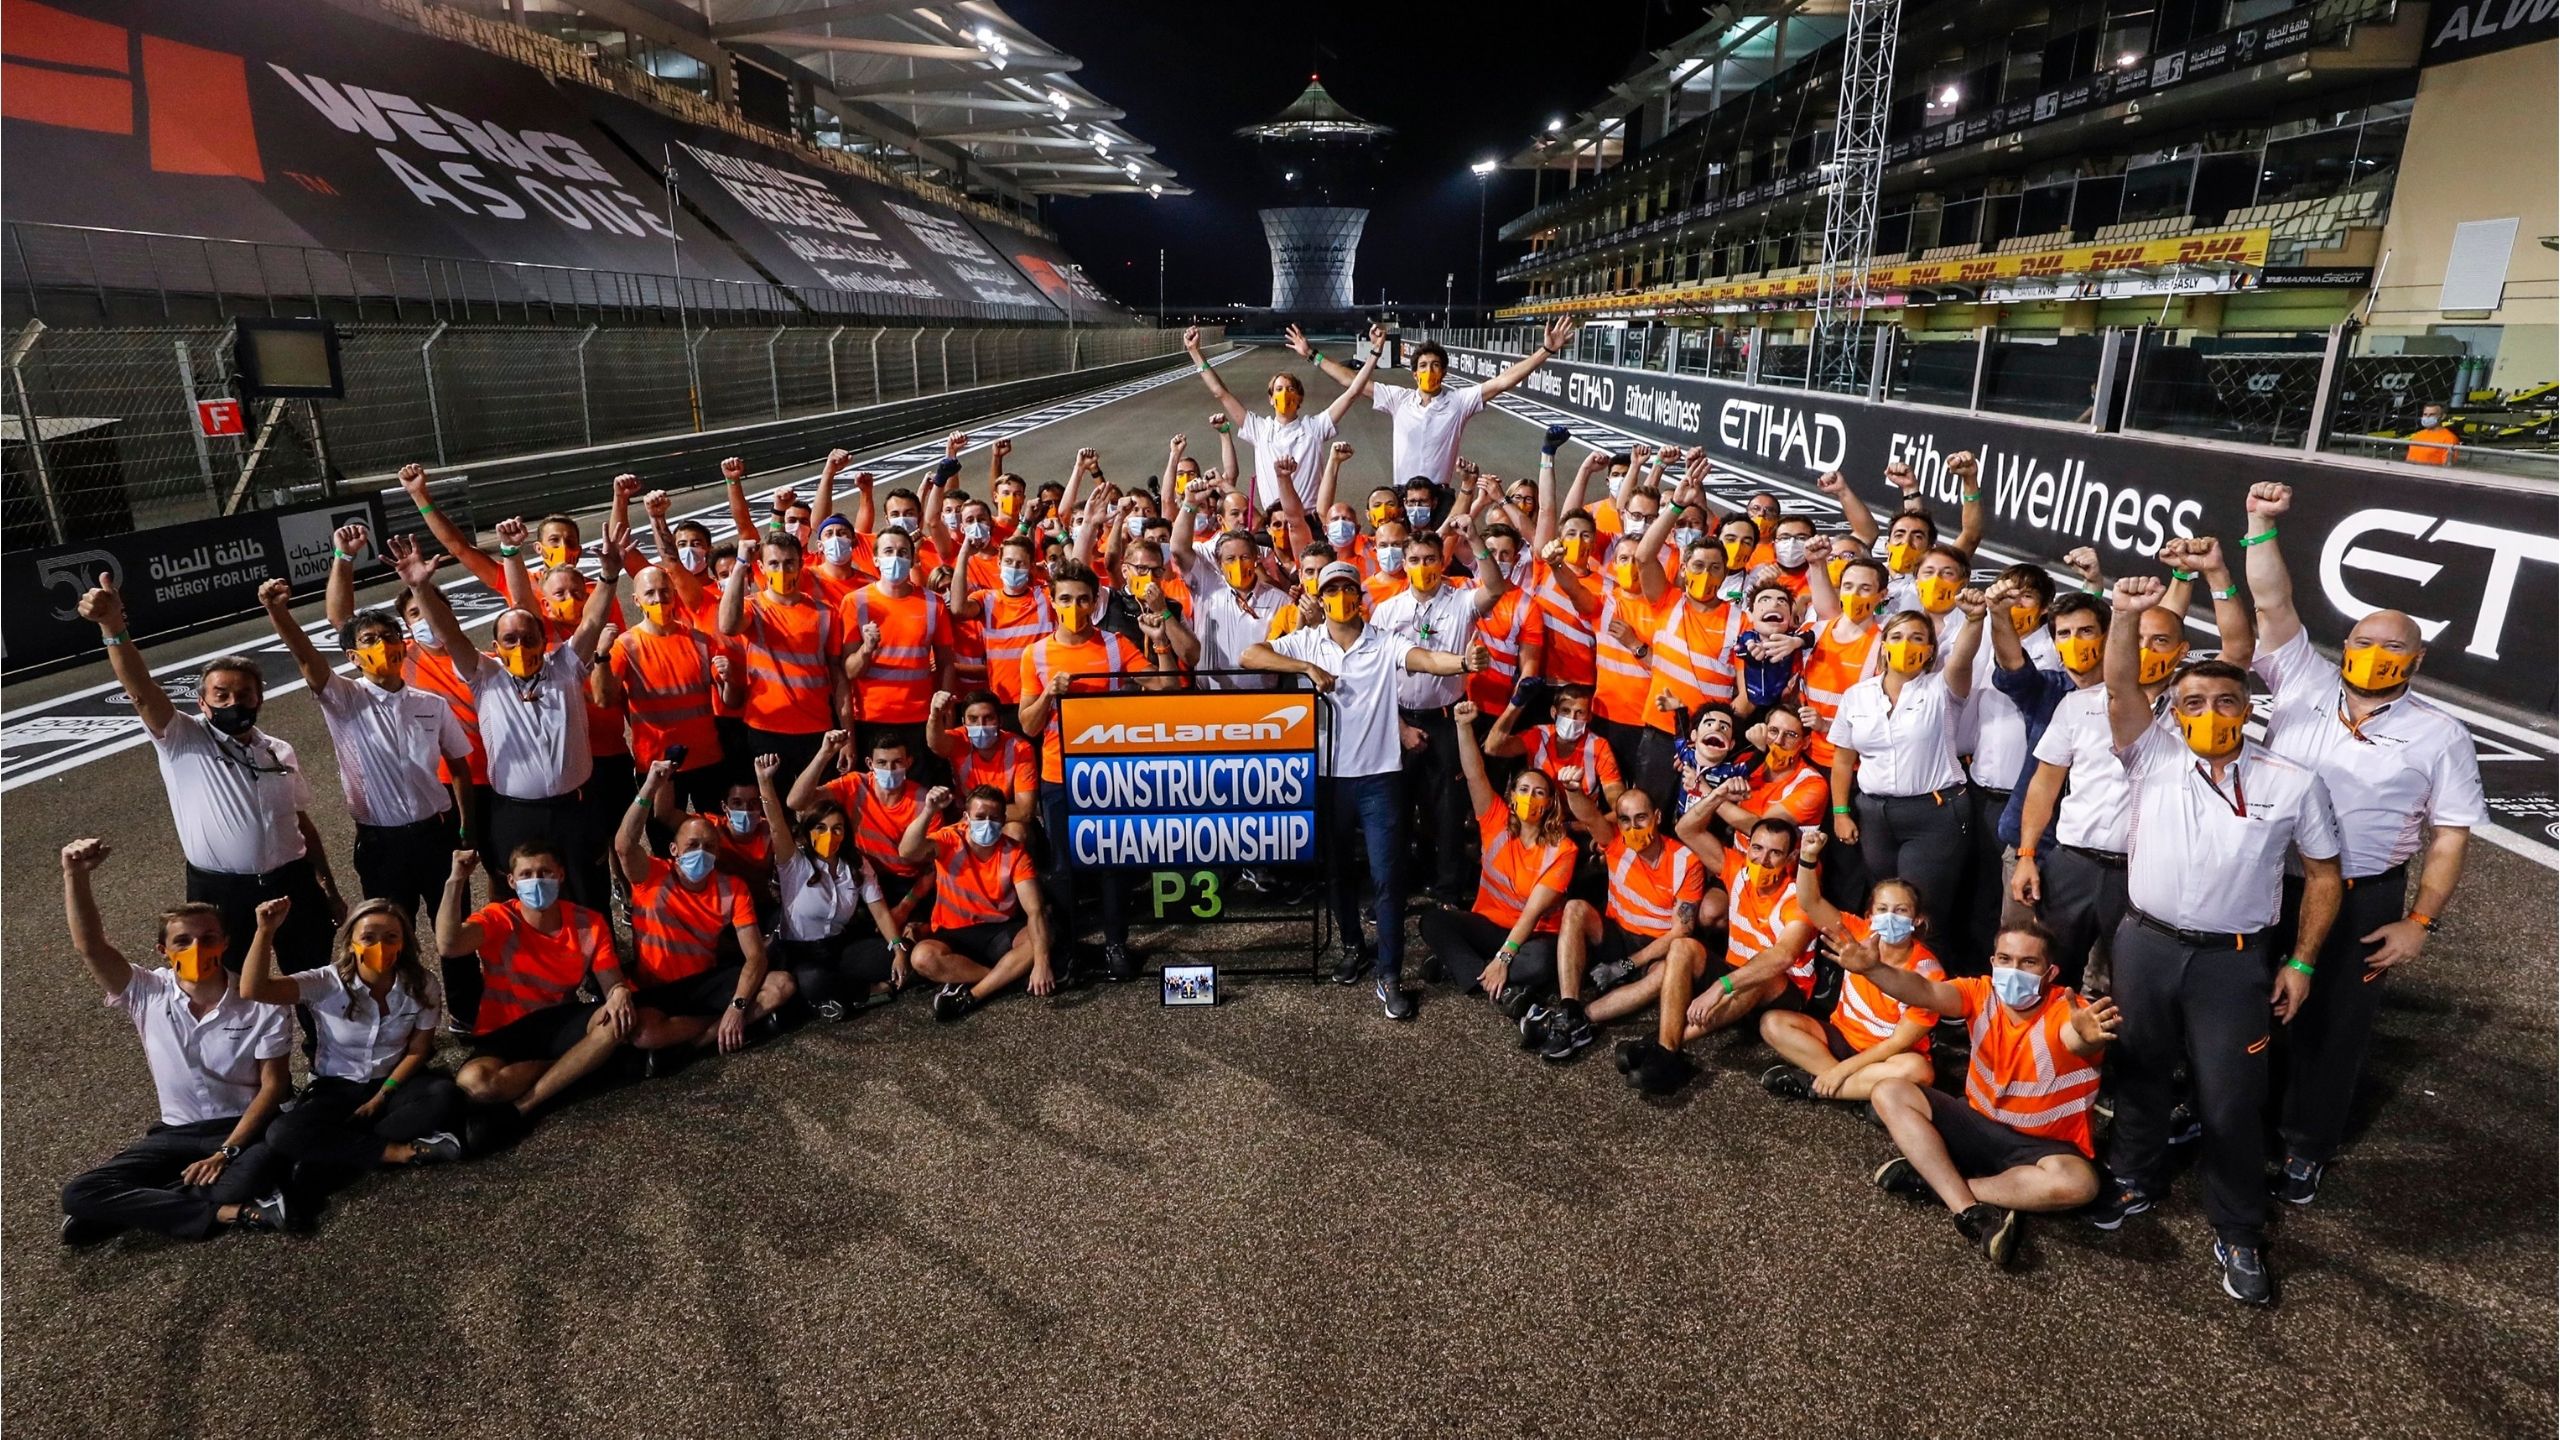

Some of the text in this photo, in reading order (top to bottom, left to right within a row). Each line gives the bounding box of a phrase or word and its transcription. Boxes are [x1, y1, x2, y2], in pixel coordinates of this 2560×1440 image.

[2431, 0, 2559, 48] ALW
[2284, 35, 2295, 44] FOR
[2296, 32, 2308, 41] LIFE
[266, 62, 623, 187] WE RACE
[376, 147, 683, 241] AS ONE
[2087, 247, 2147, 271] DHL
[2176, 237, 2248, 264] DHL
[1910, 266, 1941, 285] DHL
[1960, 261, 1998, 281] DHL
[2019, 255, 2065, 277] DHL
[1769, 282, 1787, 296] DHL
[1797, 279, 1818, 293] DHL
[1868, 271, 1894, 289] DHL
[2110, 278, 2200, 293] 10 PIERRE GASLY
[1541, 370, 1562, 397] Wellness
[1568, 372, 1615, 413] ETIHAD
[210, 406, 230, 431] F
[1625, 384, 1702, 433] Etihad Wellness
[1719, 398, 1847, 473] ETIHAD
[1996, 452, 2203, 560] Wellness
[149, 537, 265, 583] طاقة للحياة
[155, 564, 270, 603] ENERGY FOR LIFE
[1070, 722, 1282, 745] McLaren
[1071, 756, 1310, 809] CONSTRUCTORS'
[1075, 815, 1310, 866] CHAMPIONSHIP
[1152, 870, 1223, 919] P3
